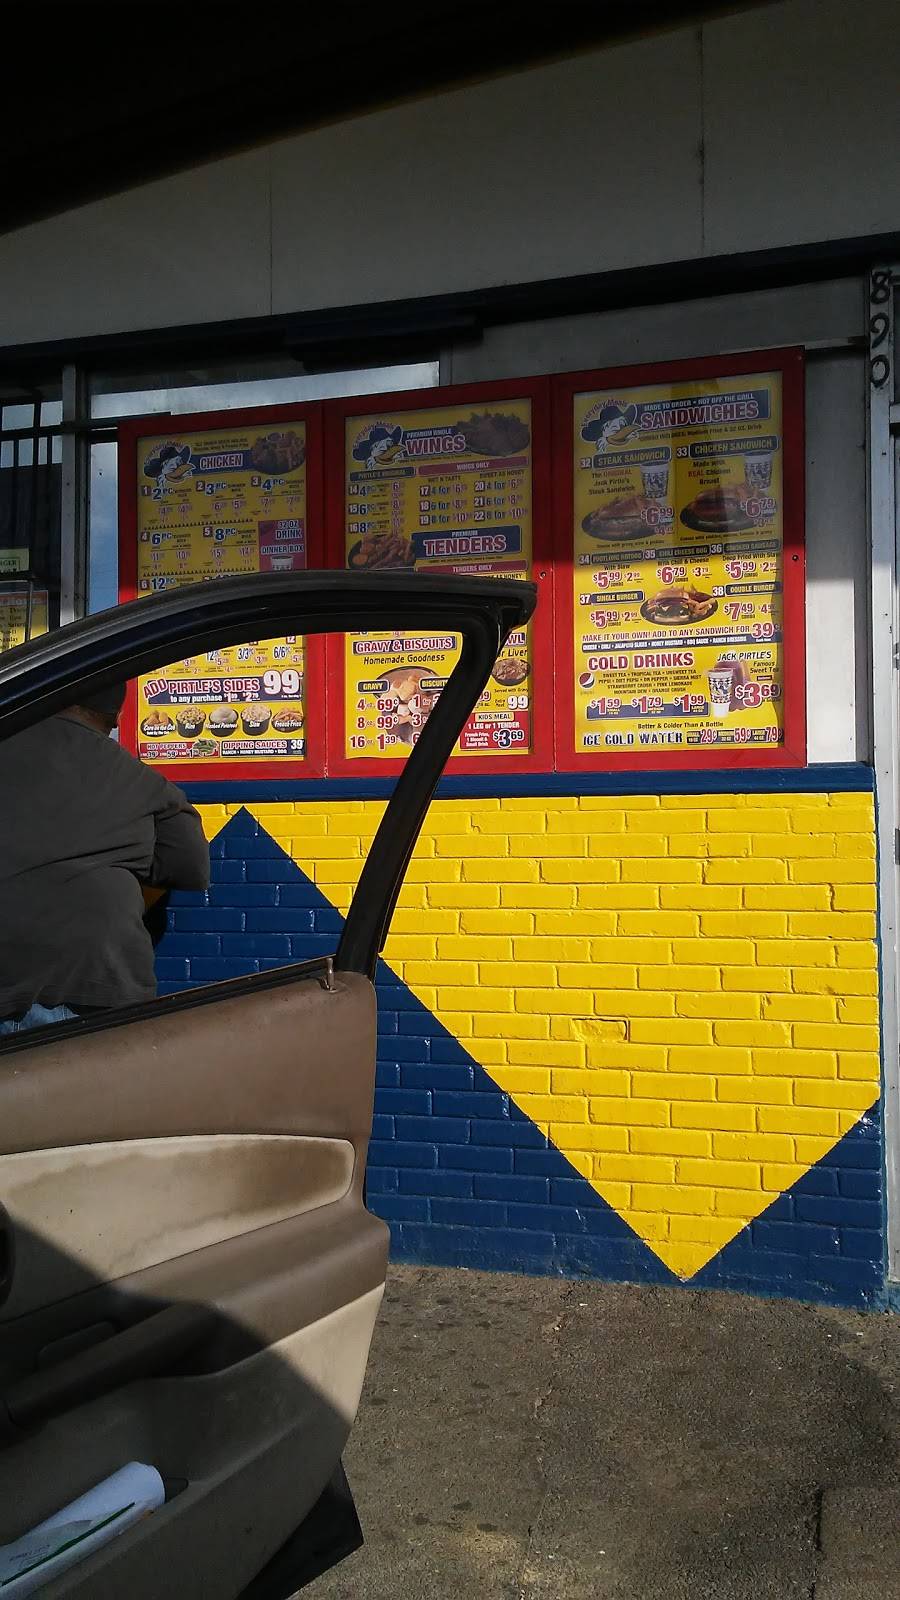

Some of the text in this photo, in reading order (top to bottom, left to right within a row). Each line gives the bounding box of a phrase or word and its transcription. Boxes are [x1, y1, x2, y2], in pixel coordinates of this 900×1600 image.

[870, 270, 890, 388] 890
[737, 392, 754, 400] GRILL
[640, 400, 759, 430] SANDWICHES
[407, 428, 452, 439] PREMIUM WHOLE
[406, 434, 465, 456] WINGS
[676, 439, 772, 457] 33 CHICKEN SANDWICH
[200, 453, 243, 470] CHICKEN
[581, 450, 665, 468] 32 STEAK SANDWICH
[457, 463, 475, 471] WINGS
[205, 483, 215, 495] 3
[262, 479, 272, 491] 4
[420, 486, 430, 496] 17
[474, 481, 485, 491] 20
[420, 501, 430, 511] 18
[474, 497, 485, 507] 21
[420, 515, 430, 525] 19
[474, 511, 485, 521] 22
[152, 533, 161, 545] 6
[215, 528, 225, 541] 8
[275, 529, 302, 540] DRINK
[261, 544, 304, 555] DINNER BOX
[423, 535, 507, 556] TENDERS
[711, 544, 722, 553] 36
[580, 555, 590, 564] 34
[645, 550, 656, 559] 35
[152, 577, 165, 590] 12
[712, 585, 752, 597] 38 DOUBLE
[580, 594, 591, 605] 37
[597, 593, 615, 602] SINGLE
[583, 634, 601, 642] MAKE
[611, 632, 630, 640] YOUR
[632, 631, 651, 639] OWN!
[652, 630, 667, 638] ADD
[669, 629, 678, 637] TO
[679, 628, 694, 636] ANY
[696, 626, 734, 635] SANDWICH
[356, 636, 453, 653] GRAVY & BISCUITS
[508, 648, 528, 657] Liver
[718, 650, 772, 661] JACK PIRTLE'S
[363, 654, 445, 665] Homemade Goodness
[588, 651, 694, 671] COLD DRINKS
[143, 678, 260, 699] ADD PIRTLE'S SIDES
[179, 696, 190, 704] any
[192, 694, 222, 704] purchase
[350, 735, 366, 748] 16
[583, 734, 601, 746] ICE
[605, 733, 634, 745] COLD
[640, 731, 682, 744] WATER
[223, 740, 288, 750] DIPPING SAUCES
